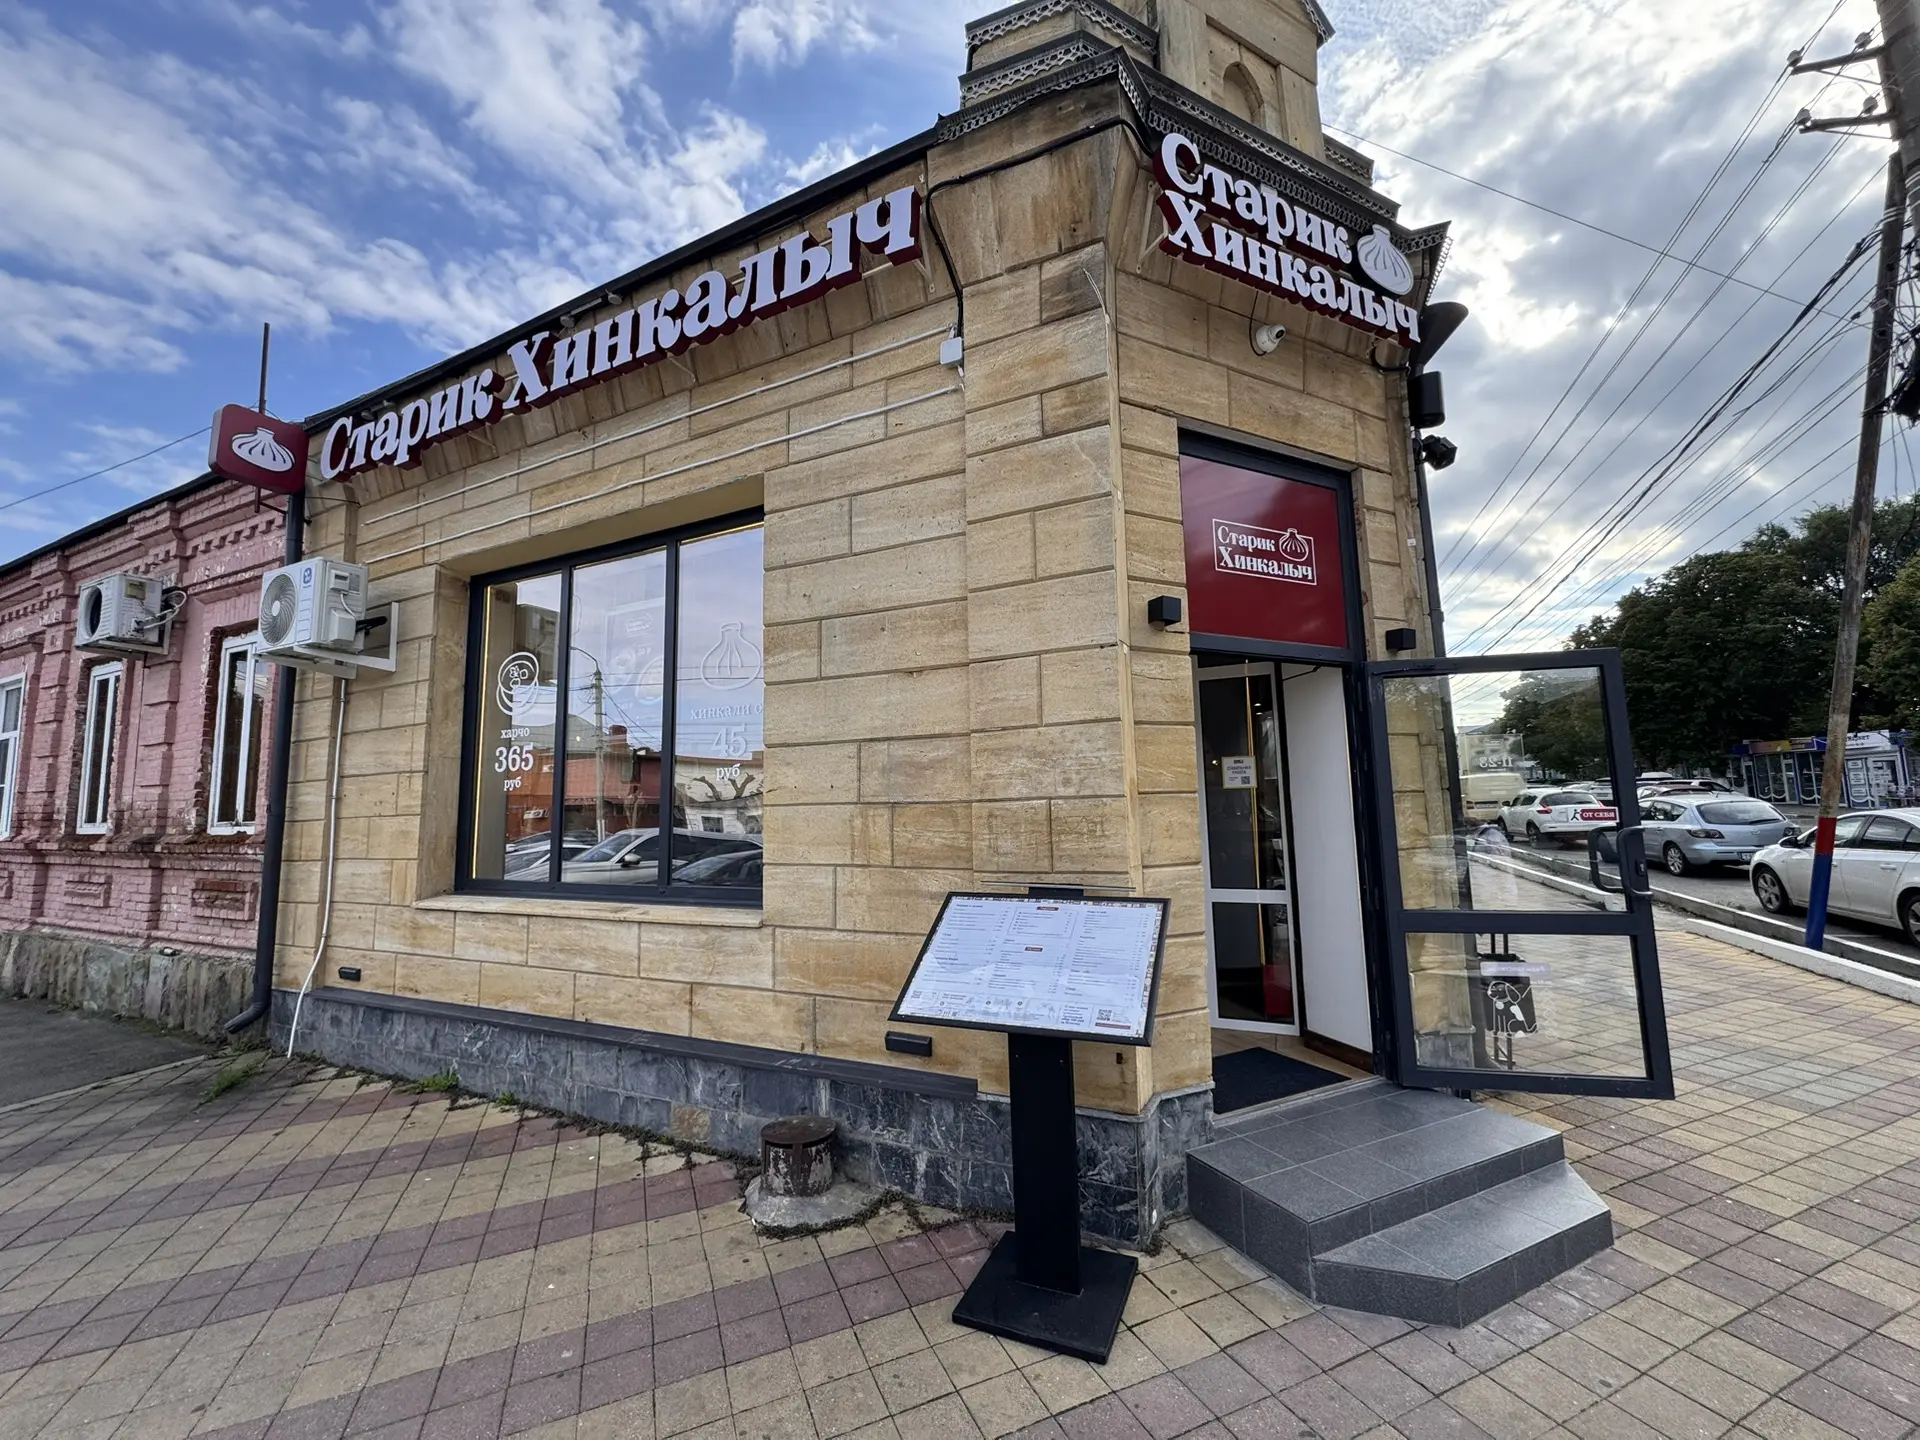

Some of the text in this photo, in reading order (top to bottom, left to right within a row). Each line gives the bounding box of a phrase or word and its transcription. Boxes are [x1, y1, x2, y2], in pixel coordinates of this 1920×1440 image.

[1161, 132, 1352, 264] Старик
[1164, 190, 1421, 343] Хинкалыч
[320, 186, 918, 481] Старик Хинкалыч
[1217, 525, 1276, 552] Старик
[1218, 546, 1313, 580] Хинкалыч
[690, 703, 764, 720] хинкали о
[500, 727, 530, 741] харчо
[711, 723, 746, 757] 45
[494, 741, 534, 773] 365
[503, 776, 522, 791] руб
[716, 763, 741, 784] руб
